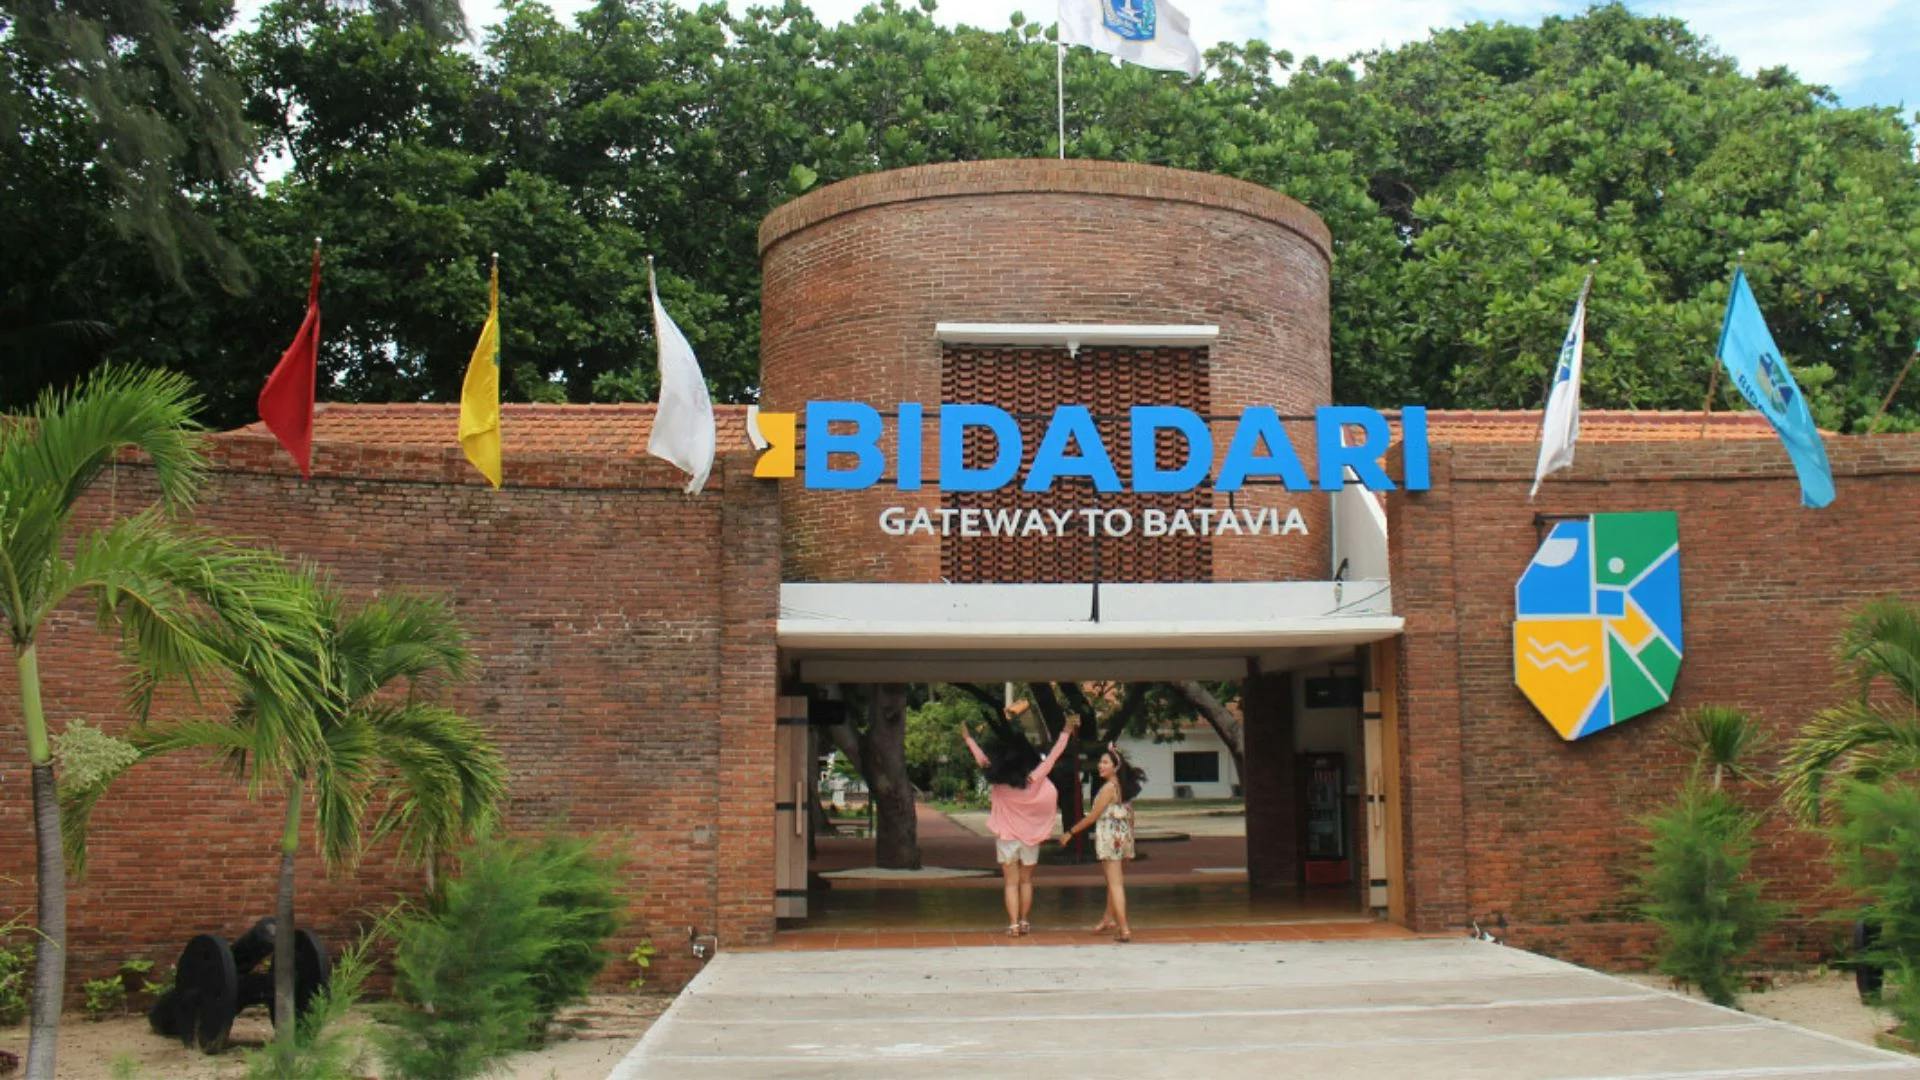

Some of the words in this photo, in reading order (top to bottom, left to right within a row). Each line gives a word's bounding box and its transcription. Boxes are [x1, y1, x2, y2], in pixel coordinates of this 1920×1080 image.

[805, 401, 1430, 492] BIDADARI
[879, 507, 1073, 537] GATEWAY
[1079, 508, 1133, 537] TO
[1143, 507, 1309, 536] BATAVIA
